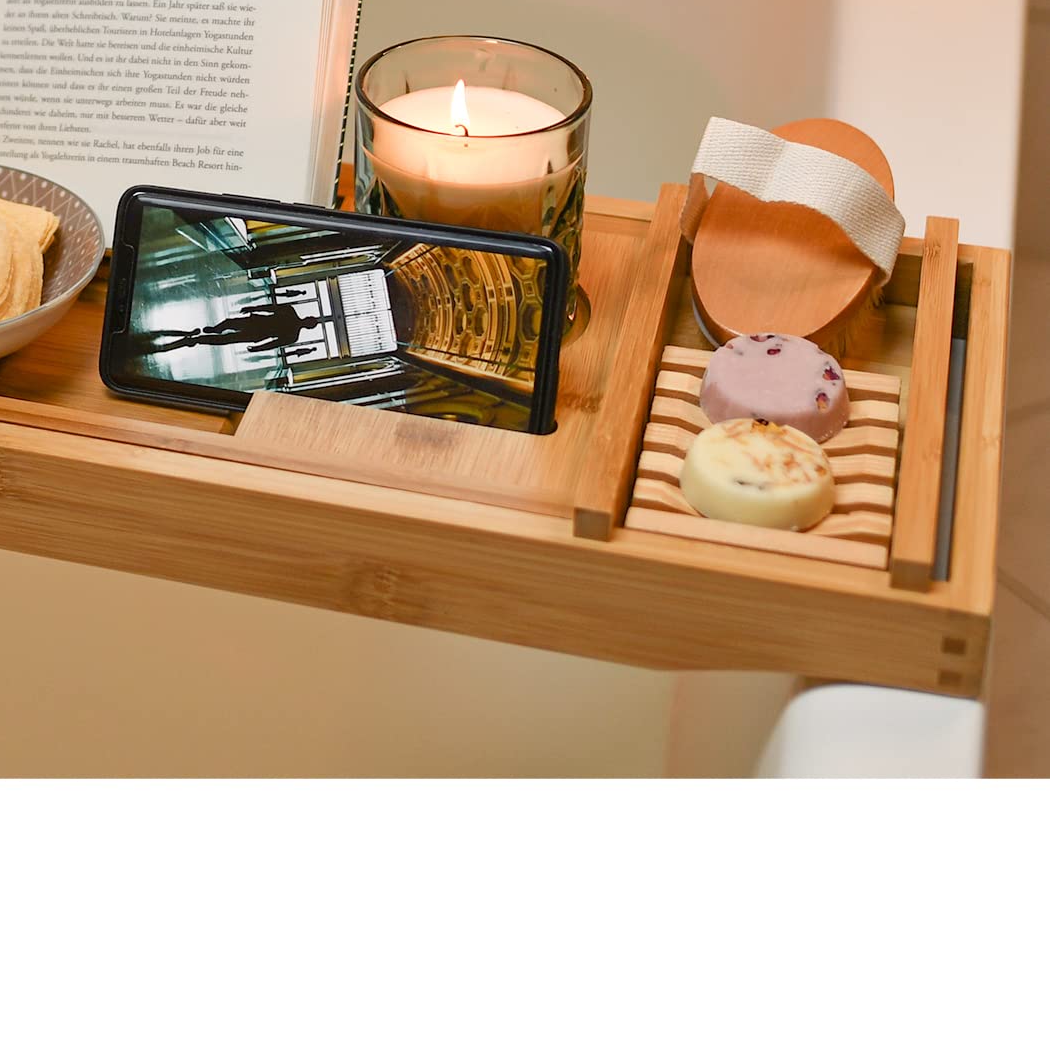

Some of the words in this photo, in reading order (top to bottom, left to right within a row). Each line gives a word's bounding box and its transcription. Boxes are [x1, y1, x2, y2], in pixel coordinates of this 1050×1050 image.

[153, 0, 166, 8] Ein
[168, 0, 184, 10] Jahr
[186, 1, 210, 12] später
[212, 2, 225, 11] saß
[227, 3, 237, 11] sie
[240, 4, 257, 12] wie-
[121, 12, 152, 22] Warum?
[155, 14, 167, 22] Sie
[211, 16, 241, 26] machte
[244, 17, 255, 27] ihr
[139, 27, 147, 36] in
[150, 28, 202, 41] Hotelanlagen
[204, 30, 254, 42] Yogastunden
[141, 41, 157, 50] und
[158, 42, 171, 51] die
[172, 43, 224, 54] einheimische
[226, 46, 253, 55] Kultur
[128, 54, 150, 64] dabei
[151, 56, 171, 65] nicht
[173, 57, 182, 66] in
[183, 57, 199, 67] den
[200, 59, 219, 68] Sinn
[221, 60, 251, 71] gekom-
[124, 69, 140, 78] ihre
[143, 70, 193, 82] Yogastunden
[195, 73, 217, 82] nicht
[220, 75, 250, 84] würden
[135, 84, 163, 95] großen
[165, 86, 181, 95] Teil
[183, 86, 197, 96] der
[200, 88, 227, 97] Freude
[230, 89, 249, 98] neh-
[115, 97, 146, 107] arbeiten
[175, 101, 184, 110] Es
[204, 102, 217, 111] die
[219, 103, 248, 114] gleiche
[149, 114, 174, 123] Wetter
[185, 115, 207, 125] dafür
[209, 117, 227, 126] aber
[229, 119, 246, 128] weit
[137, 141, 171, 152] ebenfalls
[173, 144, 194, 154] ihren
[197, 145, 211, 155] Job
[212, 146, 225, 156] für
[227, 148, 244, 157] eine
[122, 156, 170, 166] traumhaften
[172, 158, 196, 168] Beach
[197, 160, 224, 170] Resort
[225, 161, 242, 171] hin-
